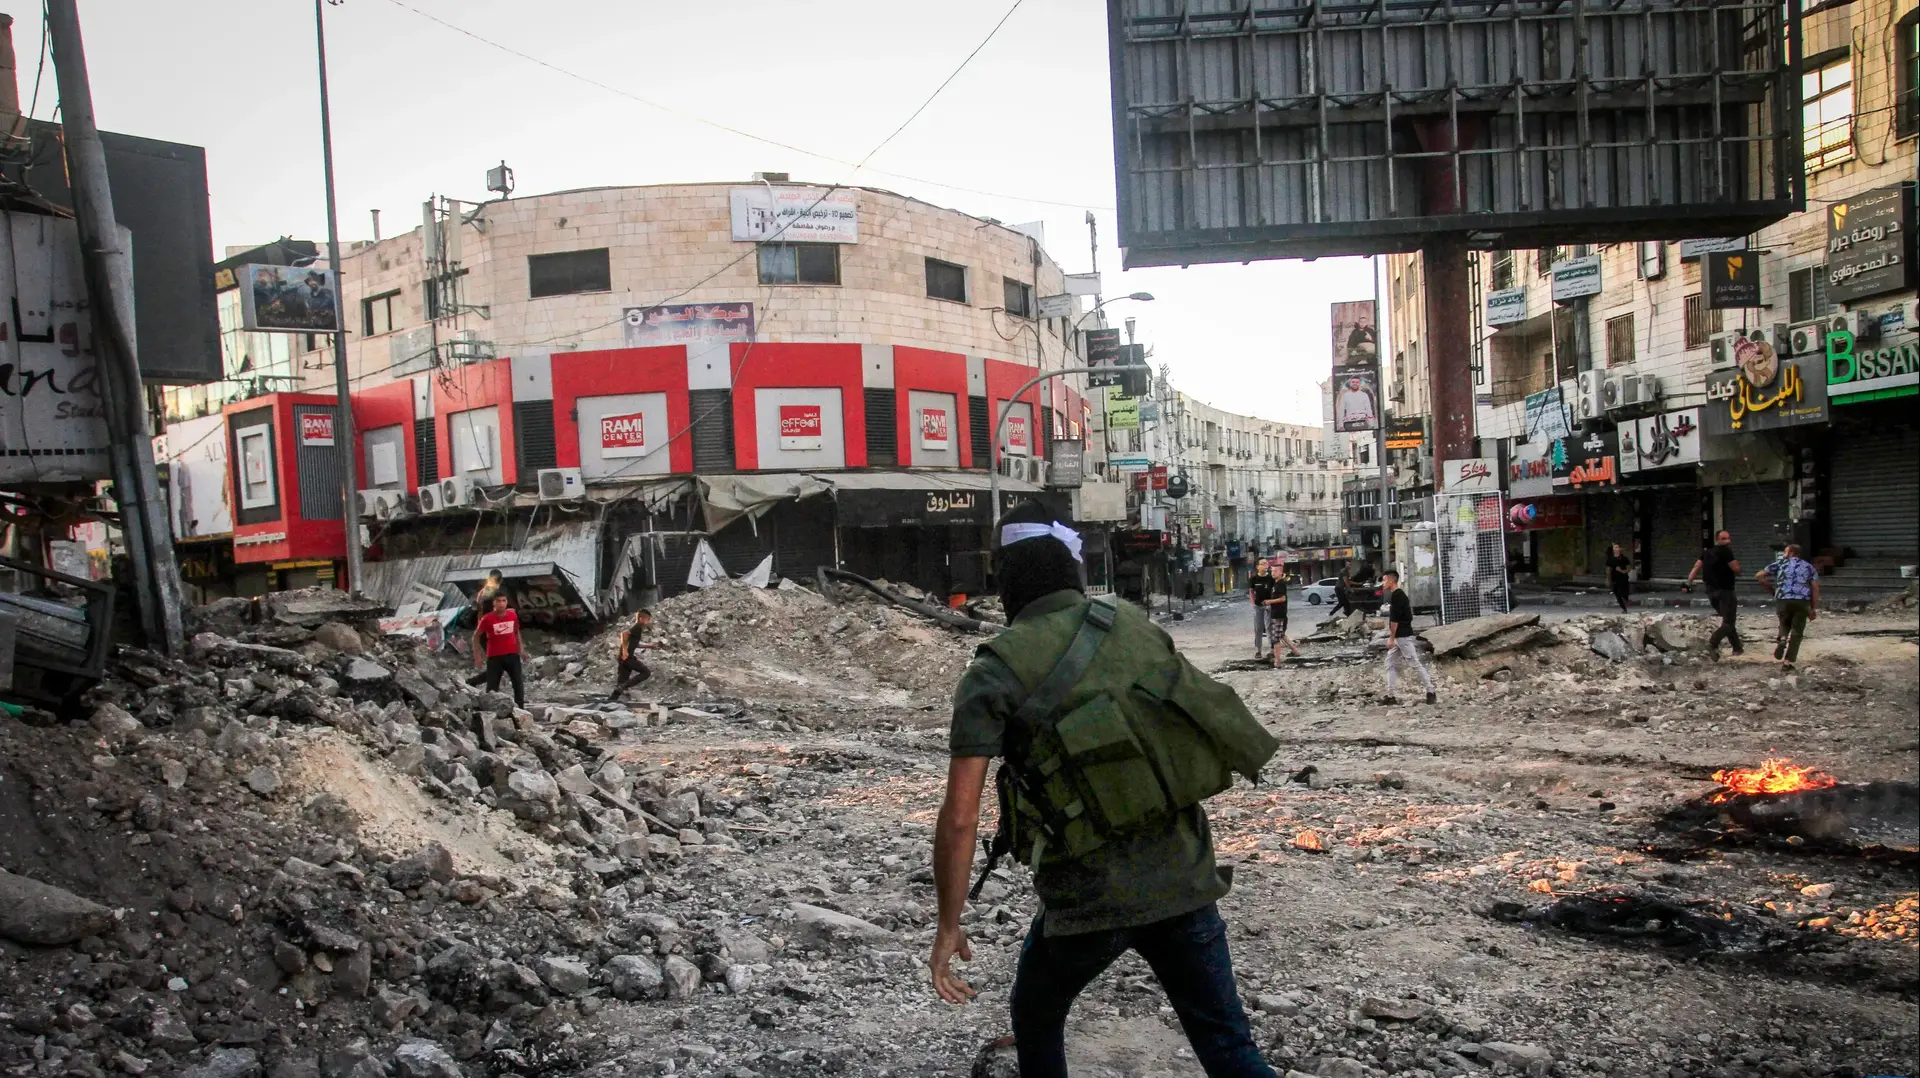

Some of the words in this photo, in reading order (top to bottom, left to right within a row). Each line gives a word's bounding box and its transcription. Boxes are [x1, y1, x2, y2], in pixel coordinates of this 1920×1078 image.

[1851, 224, 1883, 243] روضة
[1829, 234, 1850, 253] جرار
[1508, 293, 1525, 303] زياد
[695, 304, 749, 322] شركة
[1827, 331, 1918, 386] BISSAN
[1707, 379, 1737, 401] كيك
[1730, 364, 1804, 429] اللبناني
[303, 418, 332, 428] RAMI
[602, 419, 642, 434] RAMI
[923, 414, 946, 427] RAMI
[1009, 422, 1025, 433] RAMI
[603, 432, 642, 441] CENTER
[1461, 461, 1488, 486] Sky
[926, 492, 975, 512] الفاروق
